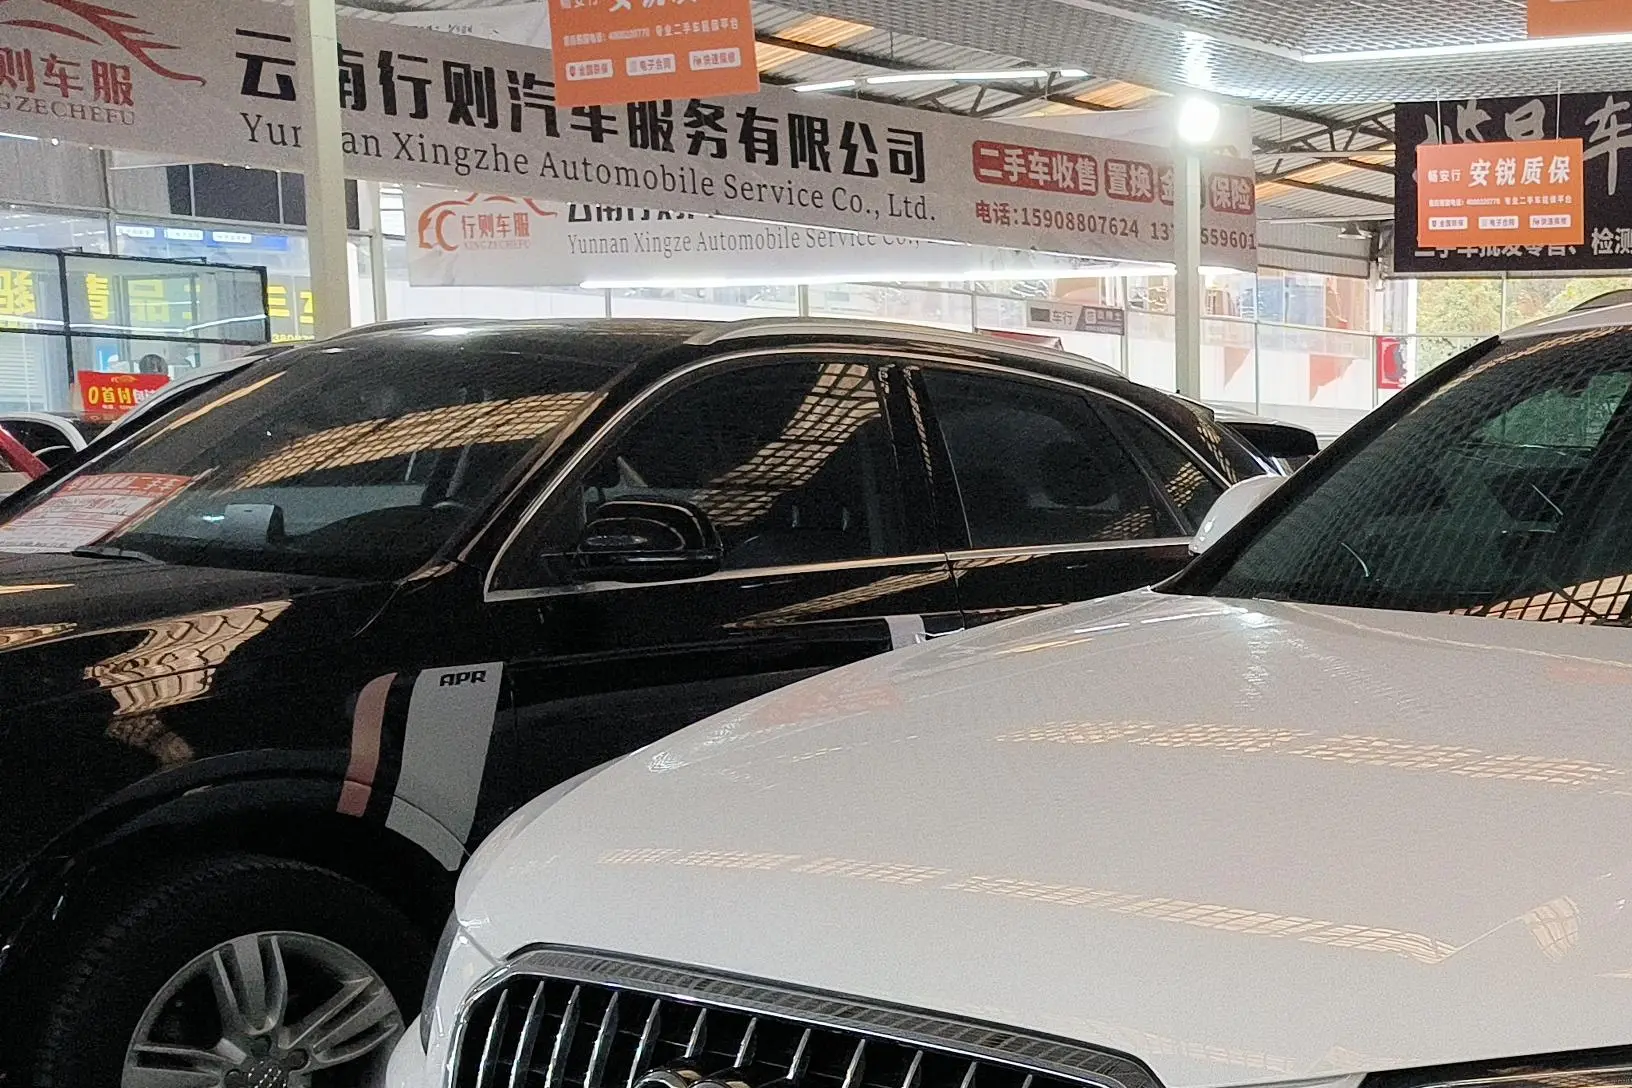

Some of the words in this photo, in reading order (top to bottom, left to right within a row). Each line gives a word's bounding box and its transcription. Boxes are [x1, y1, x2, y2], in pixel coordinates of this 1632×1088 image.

[393, 131, 528, 176] Xingzhe
[540, 151, 714, 196] Automobile
[723, 173, 824, 209] Service
[832, 187, 880, 220] Co.,
[889, 193, 936, 221] Ltd.
[1468, 155, 1571, 187] 安锐质保
[1210, 175, 1252, 210] 保险
[461, 211, 530, 239] 行则车服
[567, 233, 629, 255] Yunnan
[634, 231, 691, 259] Xingze
[697, 226, 800, 251] Automobile
[439, 670, 487, 687] APR
